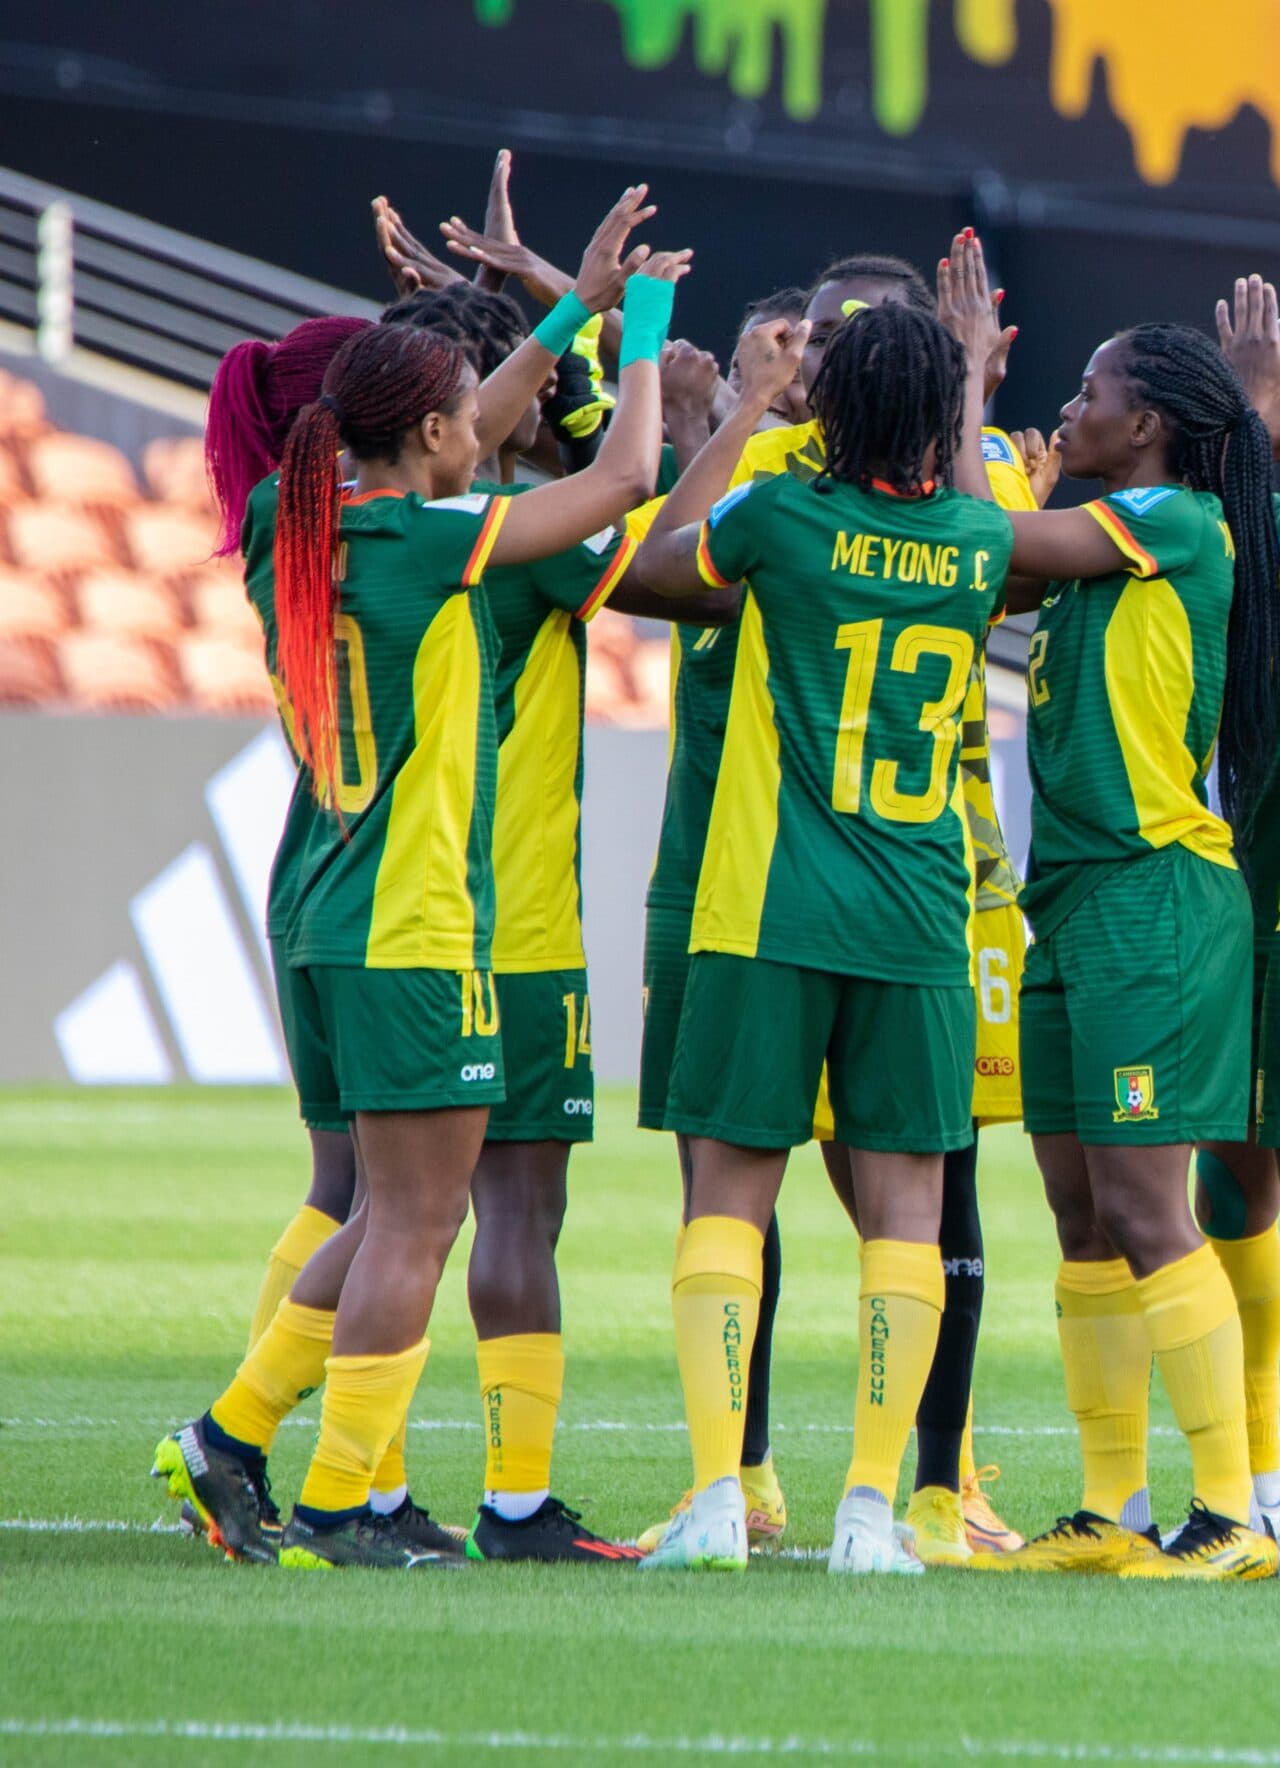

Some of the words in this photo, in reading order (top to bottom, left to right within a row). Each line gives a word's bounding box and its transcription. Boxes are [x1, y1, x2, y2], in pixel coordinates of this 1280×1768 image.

[831, 530, 959, 587] MEYONG
[832, 617, 975, 824] 13
[457, 968, 499, 1038] 10
[562, 991, 594, 1073] 14
[460, 1062, 496, 1083] one
[976, 1056, 1015, 1076] one
[563, 1097, 593, 1116] one
[722, 1302, 743, 1413] CAMEROUN
[870, 1297, 890, 1407] CAMEROUN
